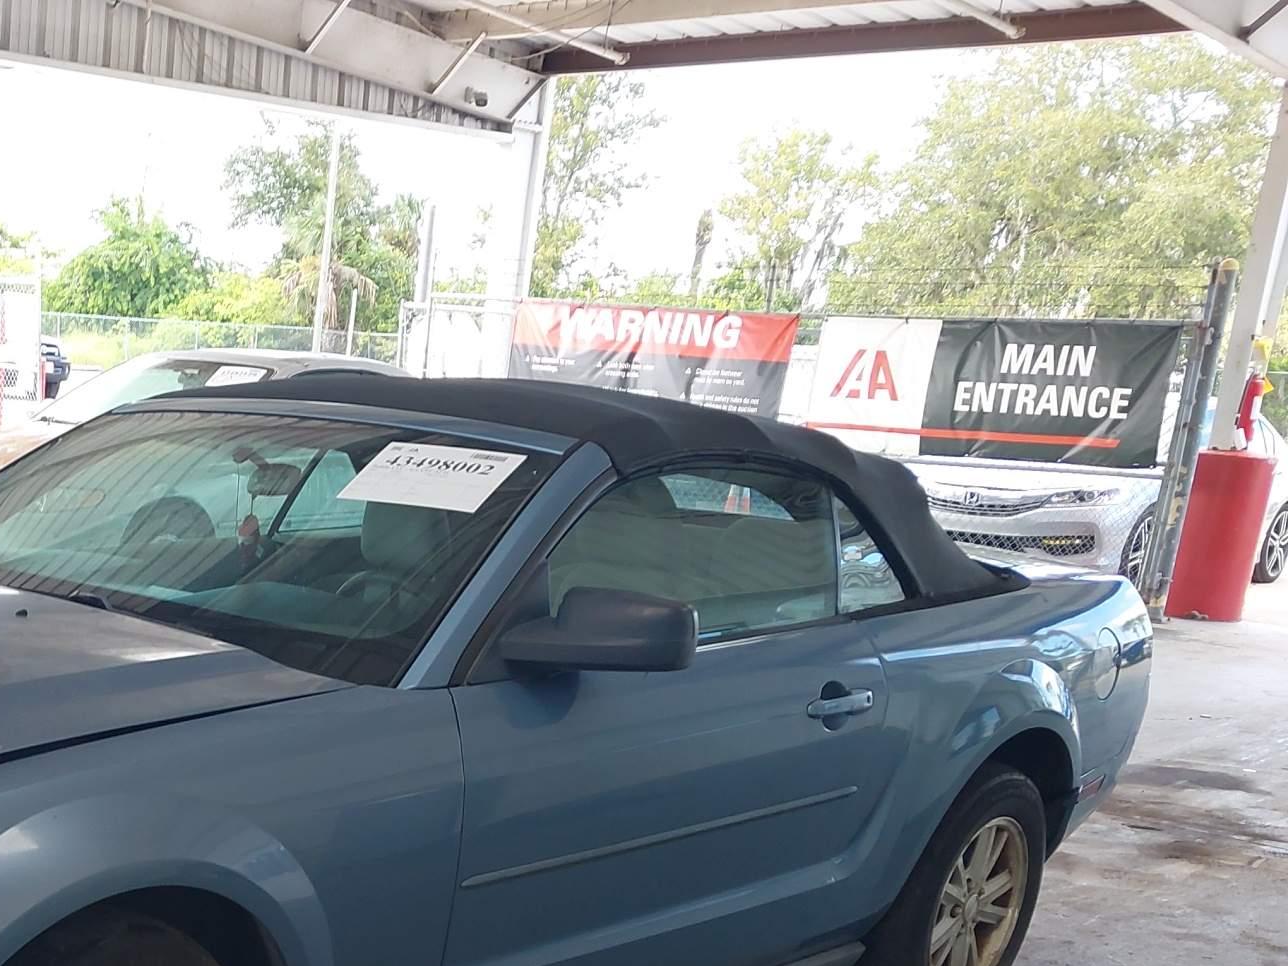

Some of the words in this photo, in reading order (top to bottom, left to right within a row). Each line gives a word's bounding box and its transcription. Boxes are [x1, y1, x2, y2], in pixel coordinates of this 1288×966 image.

[559, 307, 743, 349] WARNING
[999, 343, 1097, 377] MAIN
[952, 381, 1133, 420] ENTRANCE
[386, 455, 496, 476] 43498002
